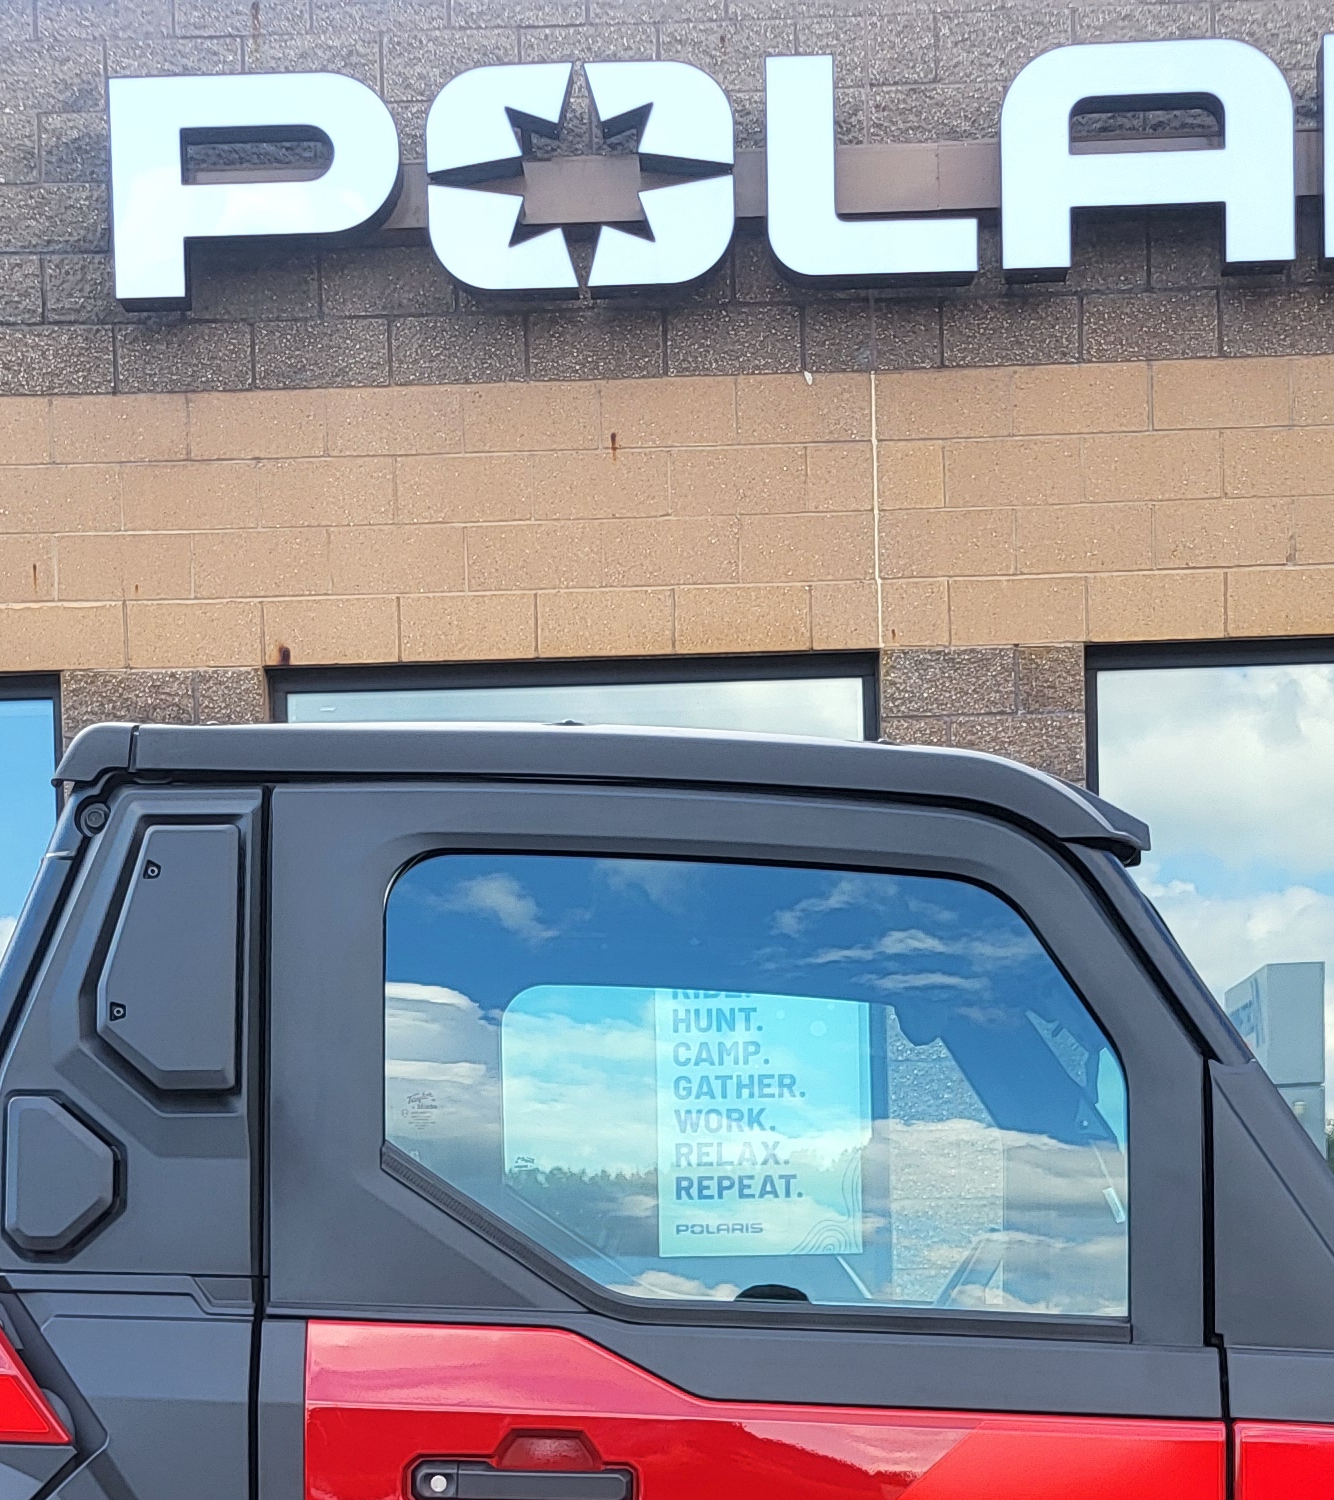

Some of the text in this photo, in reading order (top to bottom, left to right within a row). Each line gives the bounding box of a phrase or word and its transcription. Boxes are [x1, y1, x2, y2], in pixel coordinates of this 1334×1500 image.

[672, 1007, 763, 1033] HUNT.
[672, 1041, 770, 1067] CAMP.
[673, 1073, 806, 1100] GATHER.
[673, 1107, 776, 1134] WORK.
[675, 1141, 790, 1167] RELAX.
[675, 1174, 803, 1200] REPEAT.
[676, 1222, 764, 1235] POLARIS
